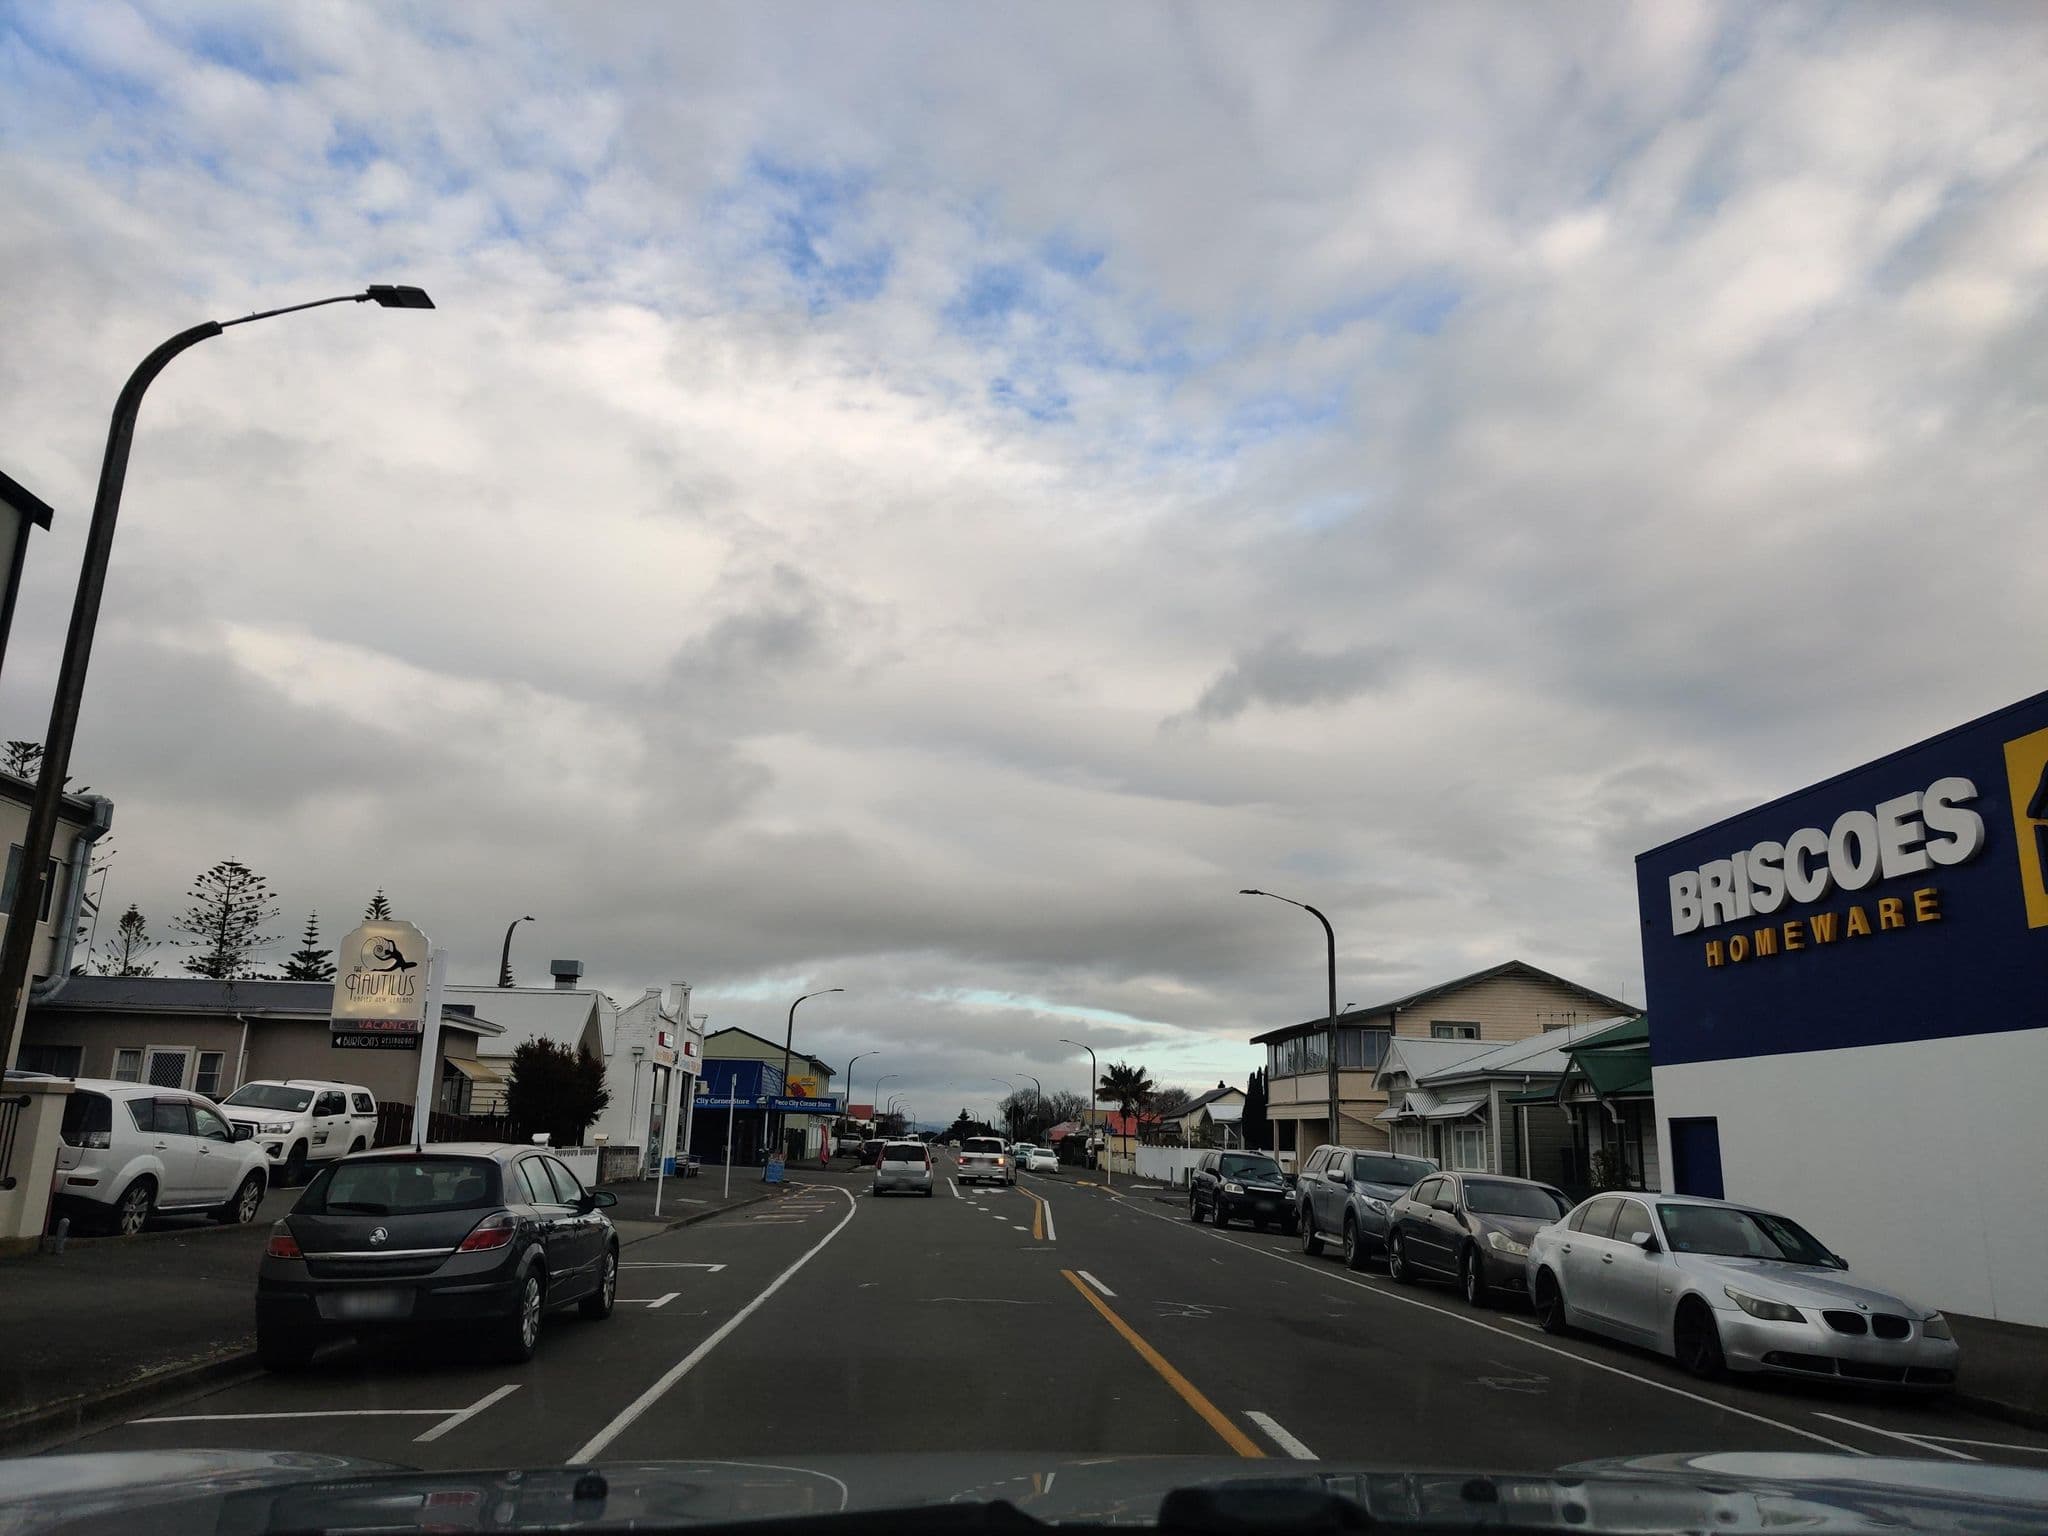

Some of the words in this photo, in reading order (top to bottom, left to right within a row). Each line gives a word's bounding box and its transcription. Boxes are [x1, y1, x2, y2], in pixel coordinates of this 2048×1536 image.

[1669, 777, 1984, 936] BRISCOES
[1705, 888, 1941, 967] HOMEWARE
[345, 973, 416, 1000] NAUTILUS
[358, 1019, 414, 1030] VACANCY
[696, 1097, 709, 1105] City
[789, 1099, 799, 1107] City
